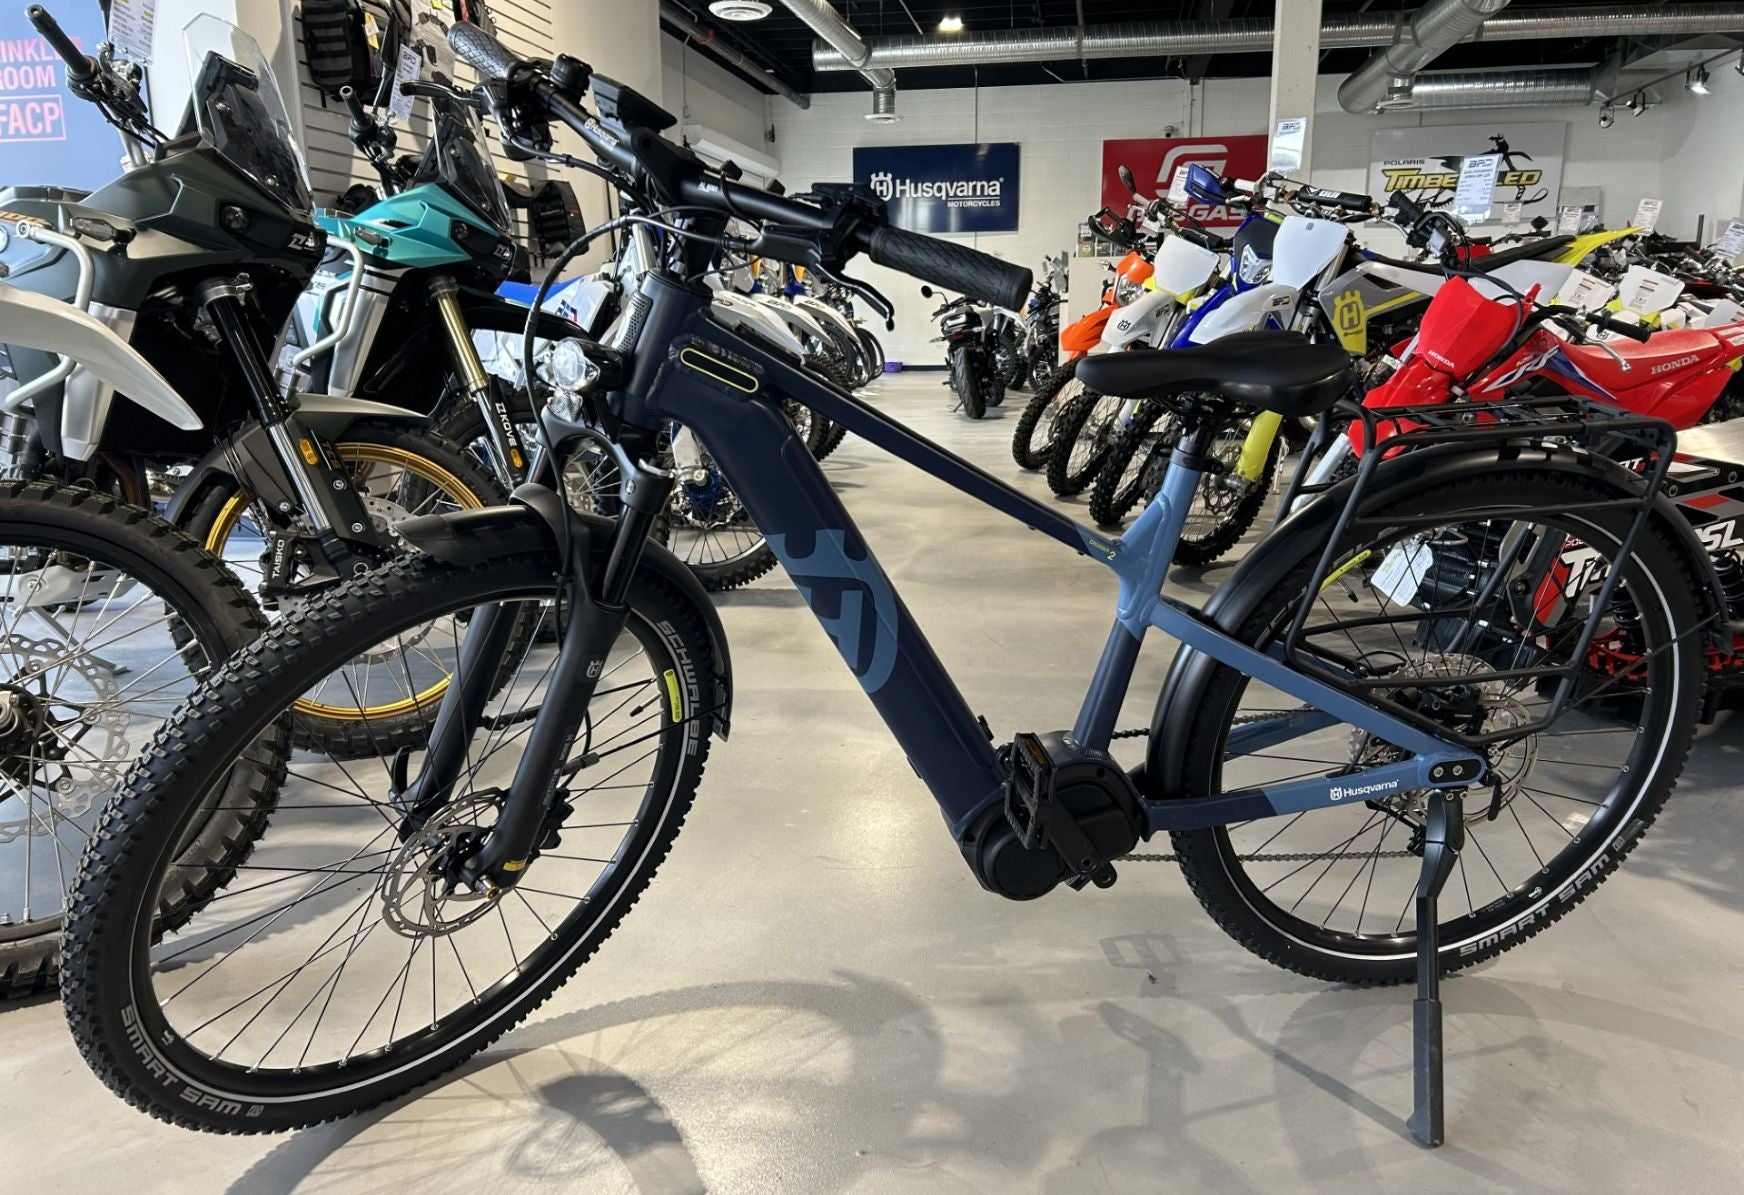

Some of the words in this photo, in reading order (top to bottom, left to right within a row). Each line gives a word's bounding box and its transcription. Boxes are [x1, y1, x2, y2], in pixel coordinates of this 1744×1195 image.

[0, 65, 56, 90] OOM
[895, 179, 1001, 200] Husqvarna
[947, 200, 1001, 208] MOTORCYCLES
[1427, 350, 1455, 369] HONDA
[1650, 354, 1700, 375] HONDA
[499, 414, 518, 447] KOVE
[271, 539, 285, 579] TAISKO
[656, 619, 700, 756] SCHWALBE
[1343, 780, 1399, 798] Husqvarna
[1459, 903, 1550, 957] SMART
[1558, 852, 1610, 904] SAM
[120, 1003, 179, 1087] SMART
[179, 1086, 242, 1116] SAM
